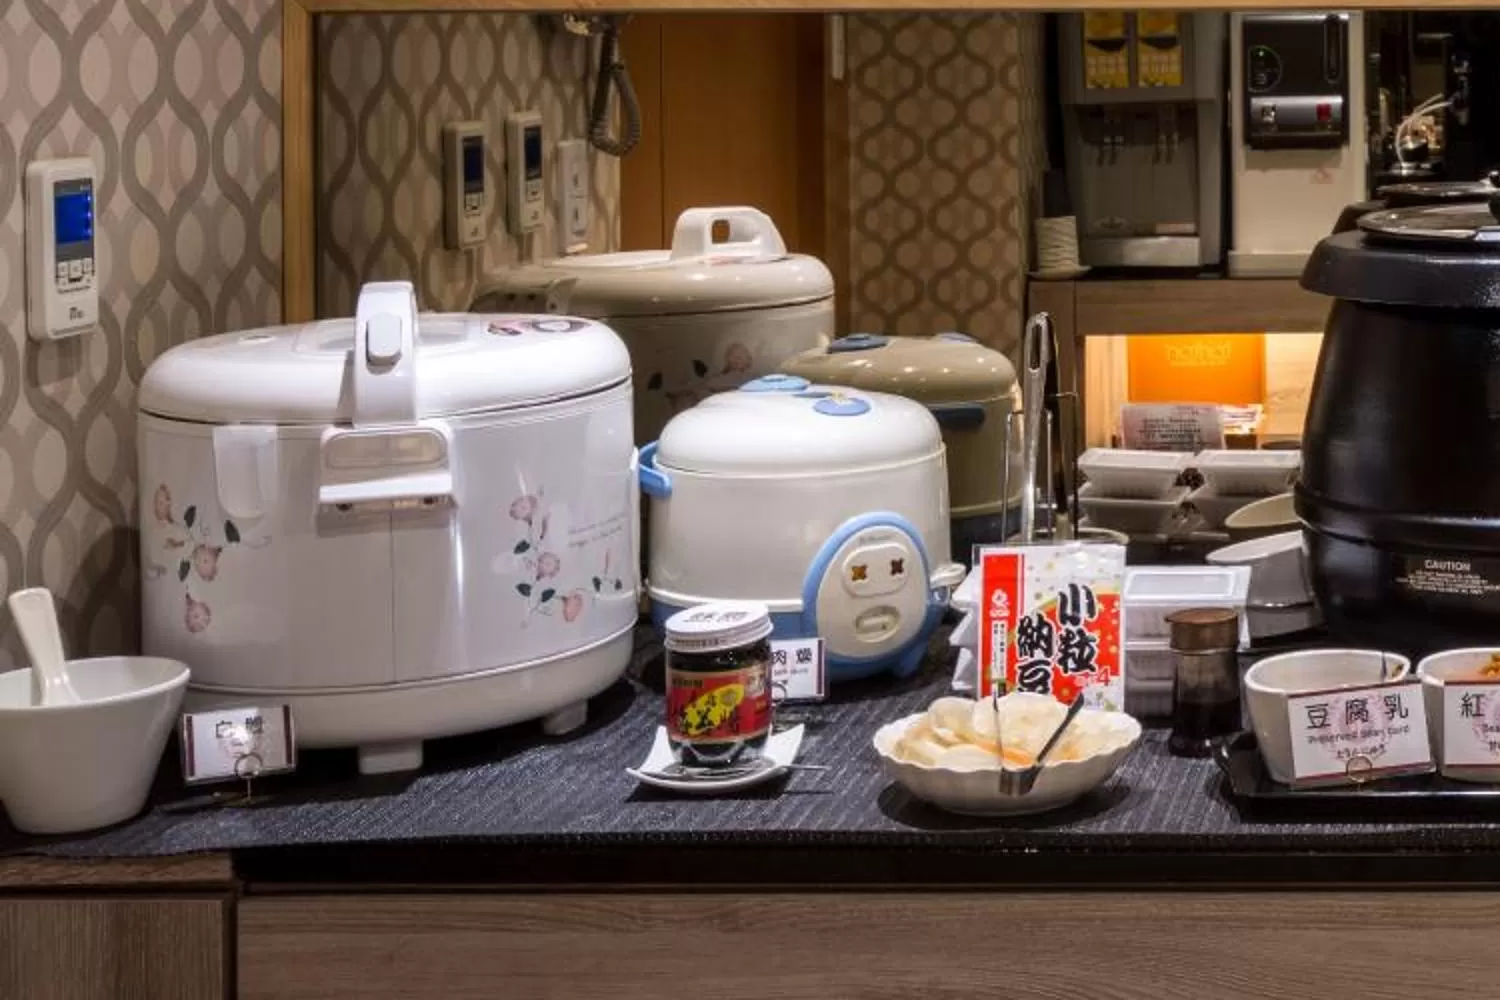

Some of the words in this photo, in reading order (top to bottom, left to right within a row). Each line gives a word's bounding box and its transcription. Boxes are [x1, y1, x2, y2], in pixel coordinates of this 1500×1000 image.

[1424, 560, 1471, 571] CAUTION
[1304, 693, 1409, 730] 豆腐乳
